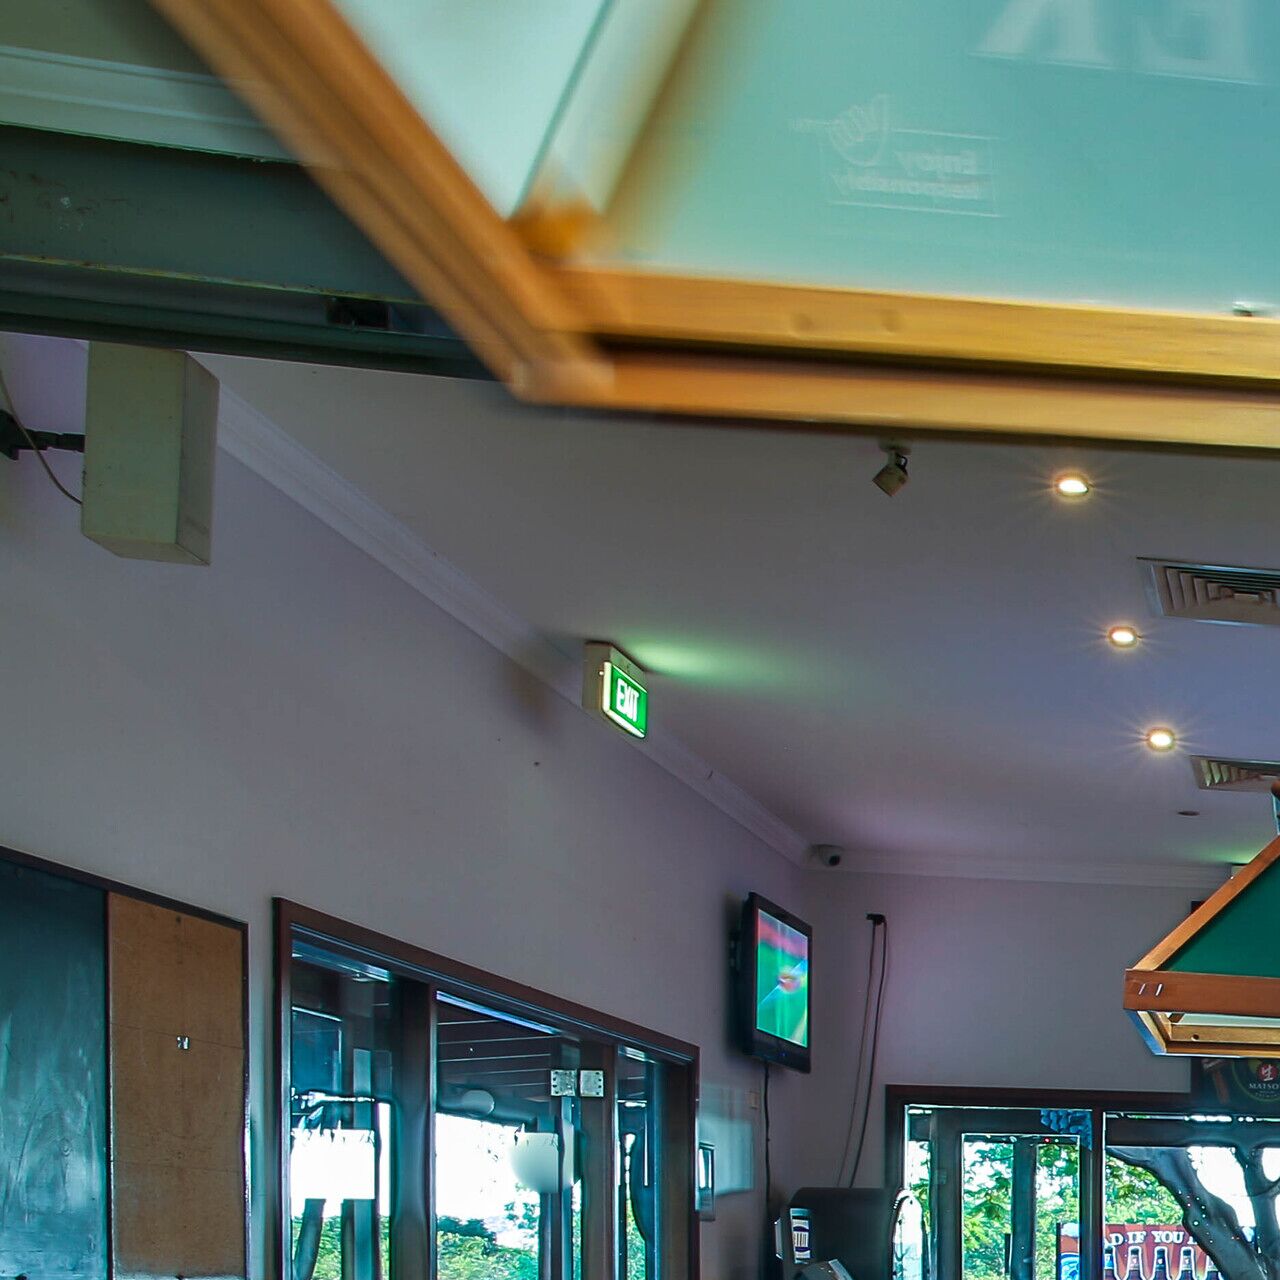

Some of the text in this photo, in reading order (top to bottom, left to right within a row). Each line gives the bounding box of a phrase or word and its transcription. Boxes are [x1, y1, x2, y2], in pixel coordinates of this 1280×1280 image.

[616, 678, 640, 722] EXIT
[1127, 1231, 1146, 1244] IF
[1151, 1231, 1184, 1244] YOU
